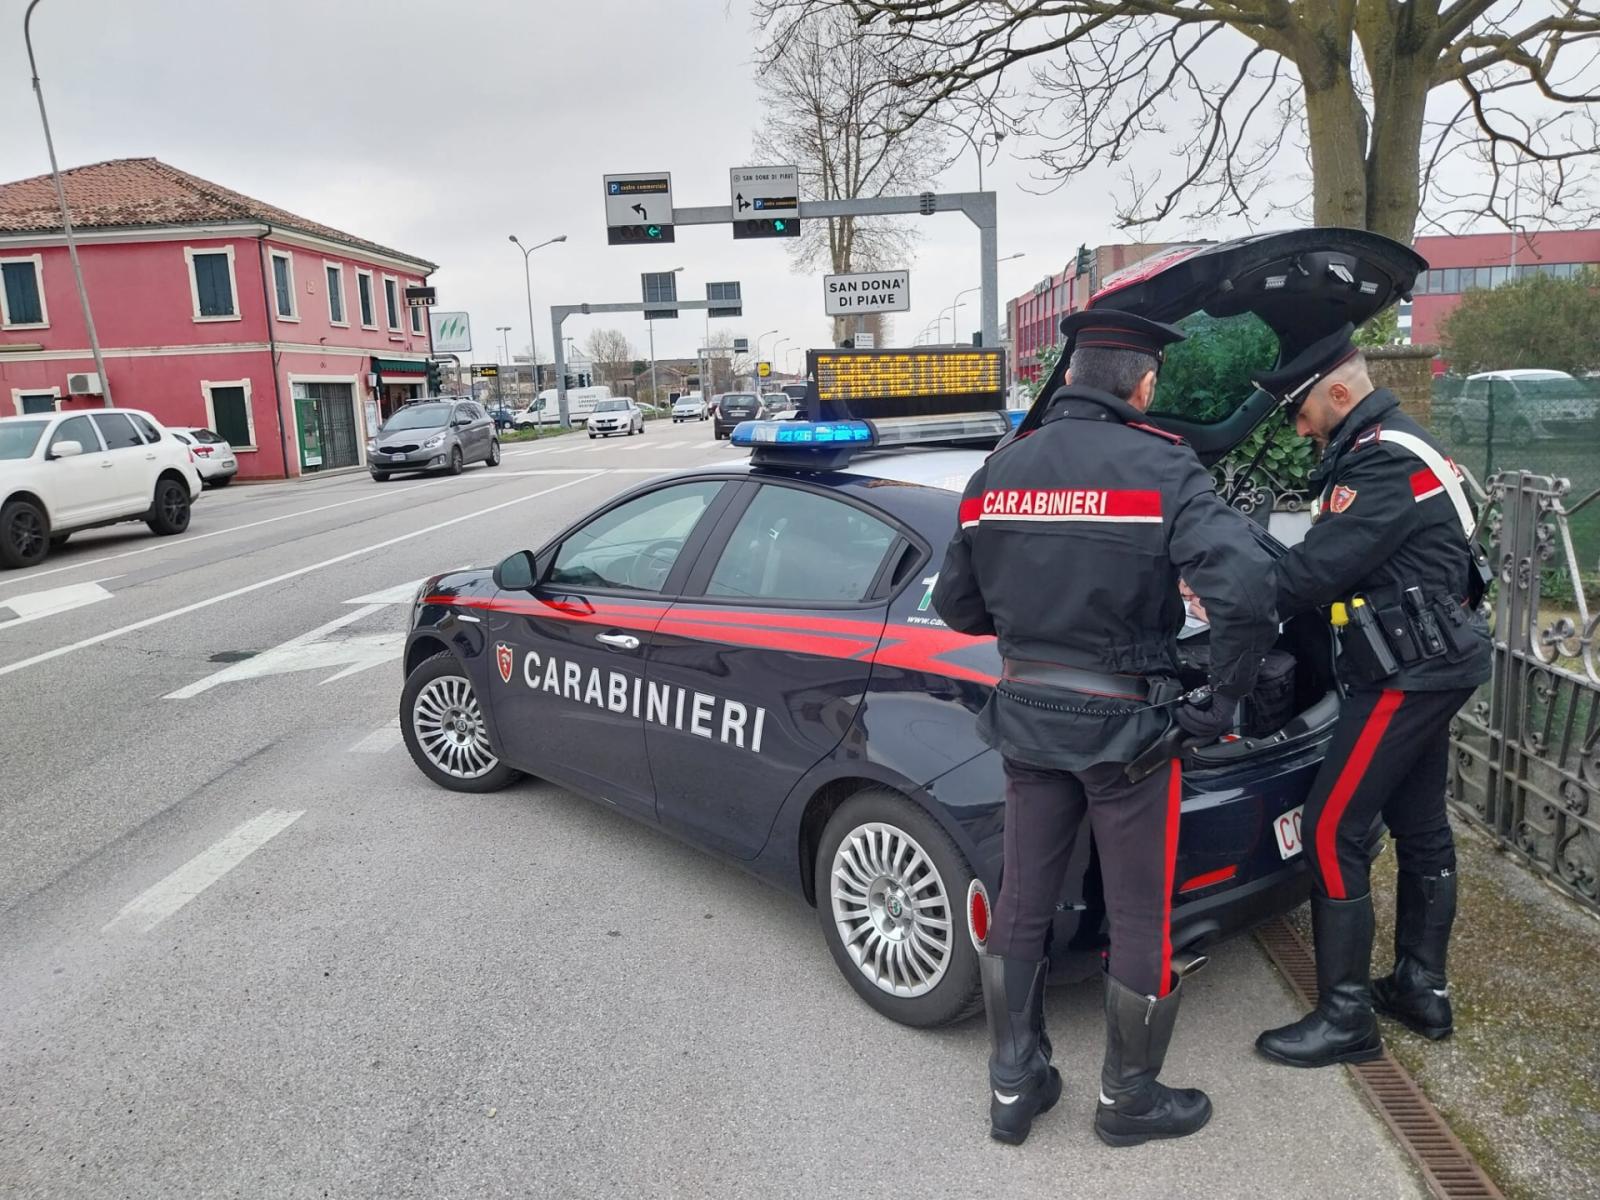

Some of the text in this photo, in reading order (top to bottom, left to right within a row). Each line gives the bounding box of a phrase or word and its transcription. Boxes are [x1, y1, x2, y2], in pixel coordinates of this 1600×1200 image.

[829, 278, 905, 293] SAN DONA'
[839, 294, 896, 307] DI PIAVE
[817, 352, 998, 400] CARABINIERI
[983, 491, 1108, 515] CARABINIERI
[523, 650, 766, 753] CARABINIERI
